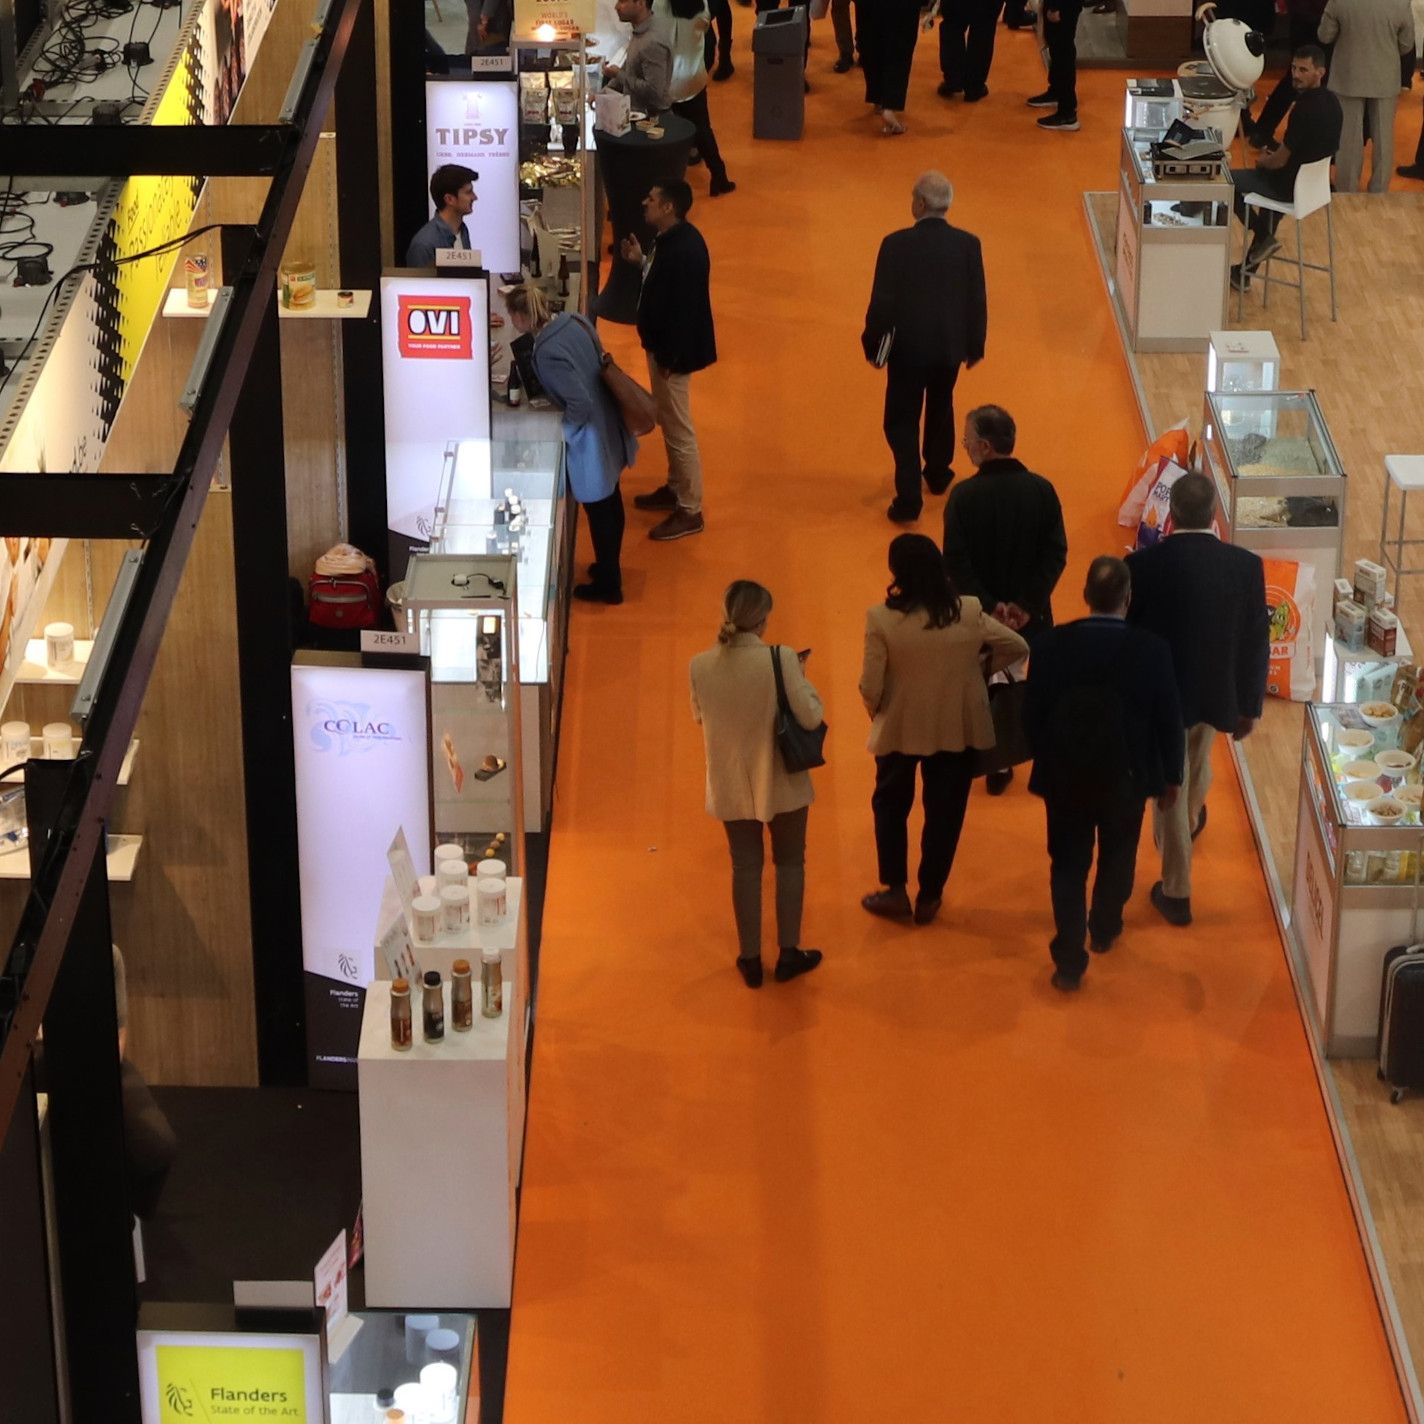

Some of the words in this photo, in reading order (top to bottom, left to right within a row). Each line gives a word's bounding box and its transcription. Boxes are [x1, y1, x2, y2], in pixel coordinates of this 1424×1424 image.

[435, 127, 510, 147] TIPSY
[407, 309, 461, 337] OVI
[373, 633, 407, 646] 2E451
[210, 1387, 288, 1404] Flanders
[210, 1405, 240, 1416] State
[242, 1404, 253, 1416] of
[255, 1405, 273, 1416] the
[279, 1405, 299, 1417] Art
